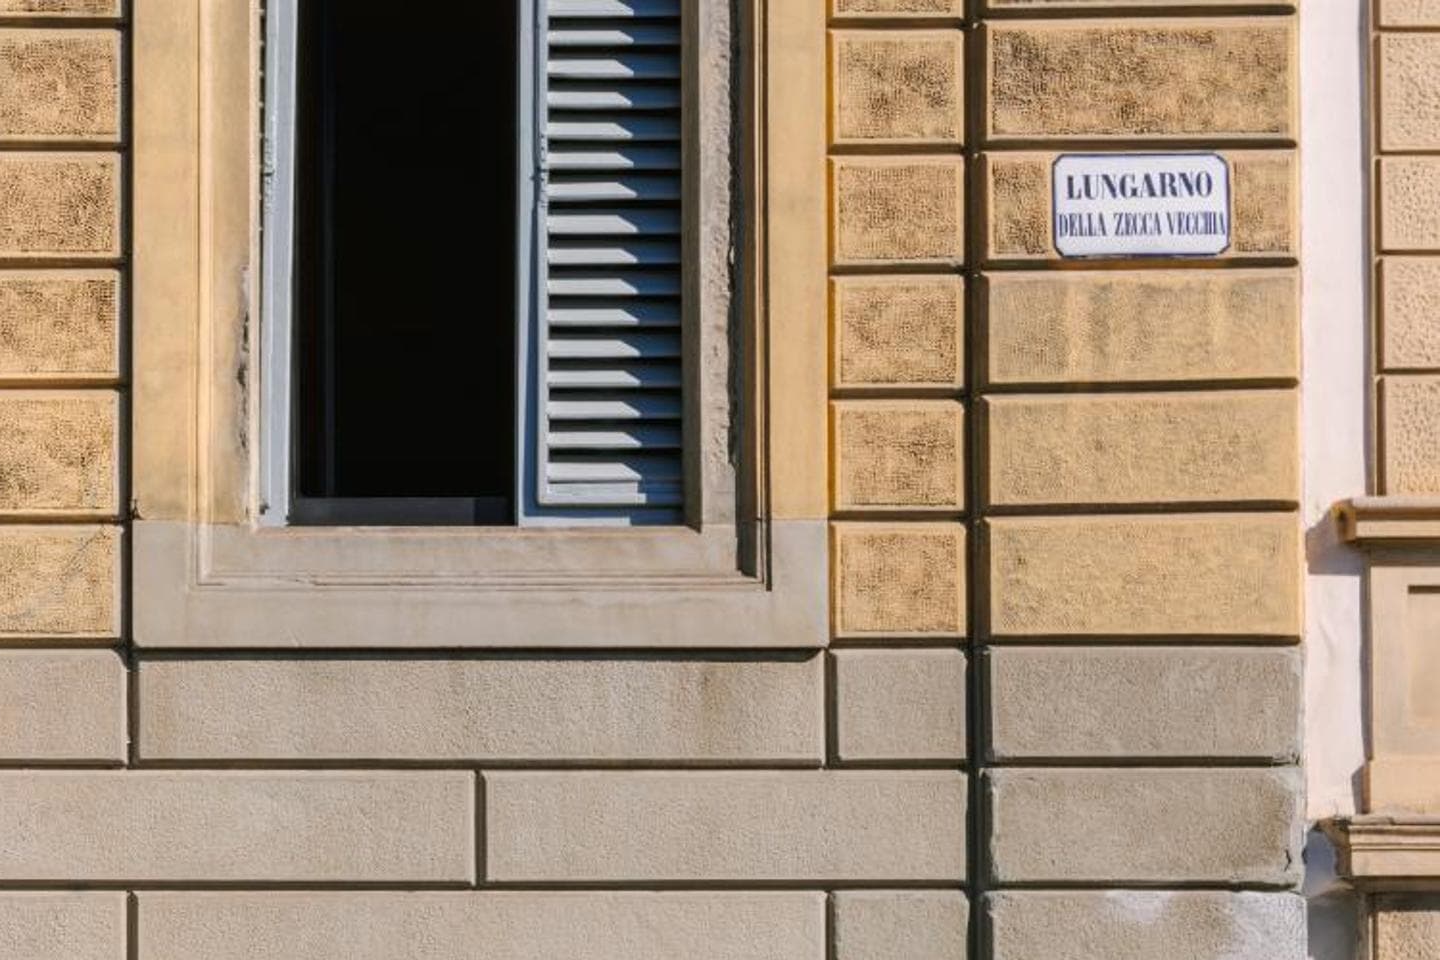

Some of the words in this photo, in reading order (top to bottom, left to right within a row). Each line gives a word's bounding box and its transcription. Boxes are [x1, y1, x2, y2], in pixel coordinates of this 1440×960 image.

[1066, 170, 1213, 200] LUNGARNO
[1059, 212, 1107, 237] DELLA
[1113, 211, 1162, 236] ZECCA
[1165, 210, 1227, 236] VECCHIA
